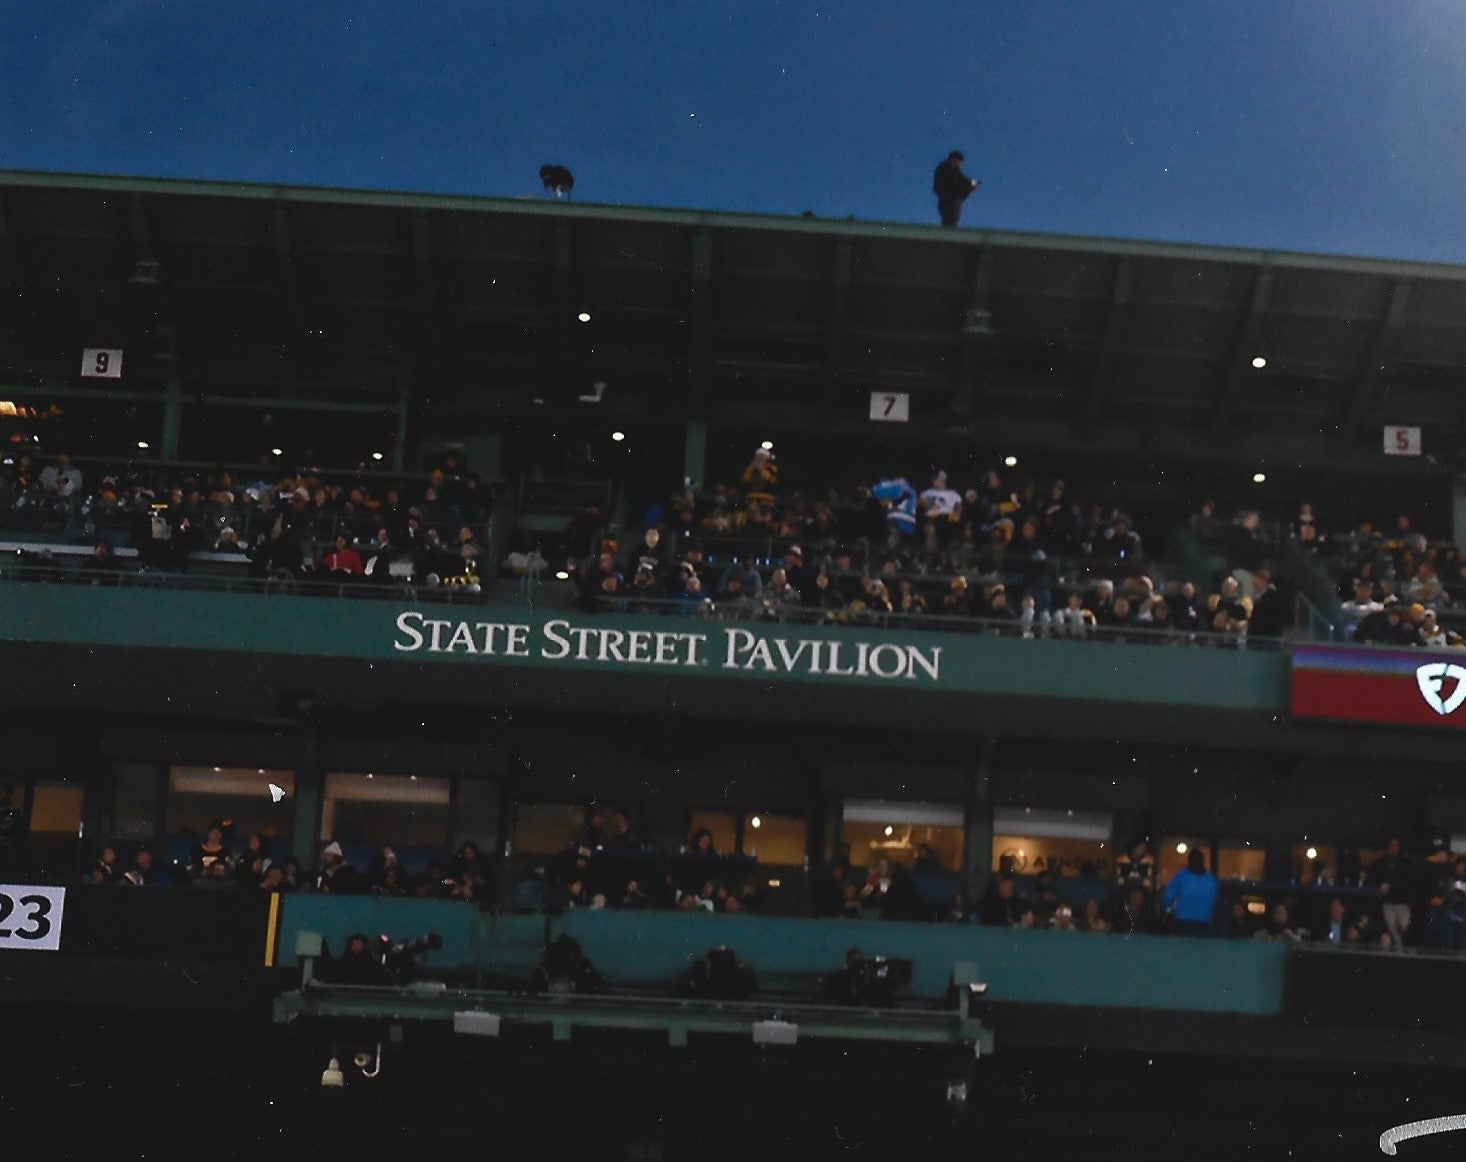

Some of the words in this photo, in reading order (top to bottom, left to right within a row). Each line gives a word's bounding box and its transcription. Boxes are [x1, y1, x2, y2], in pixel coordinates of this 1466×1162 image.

[94, 352, 109, 374] 9
[884, 396, 896, 416] 7
[1396, 429, 1409, 450] 5
[394, 610, 530, 657] STATE
[541, 619, 706, 667] STREET
[722, 628, 942, 681] PAVILION
